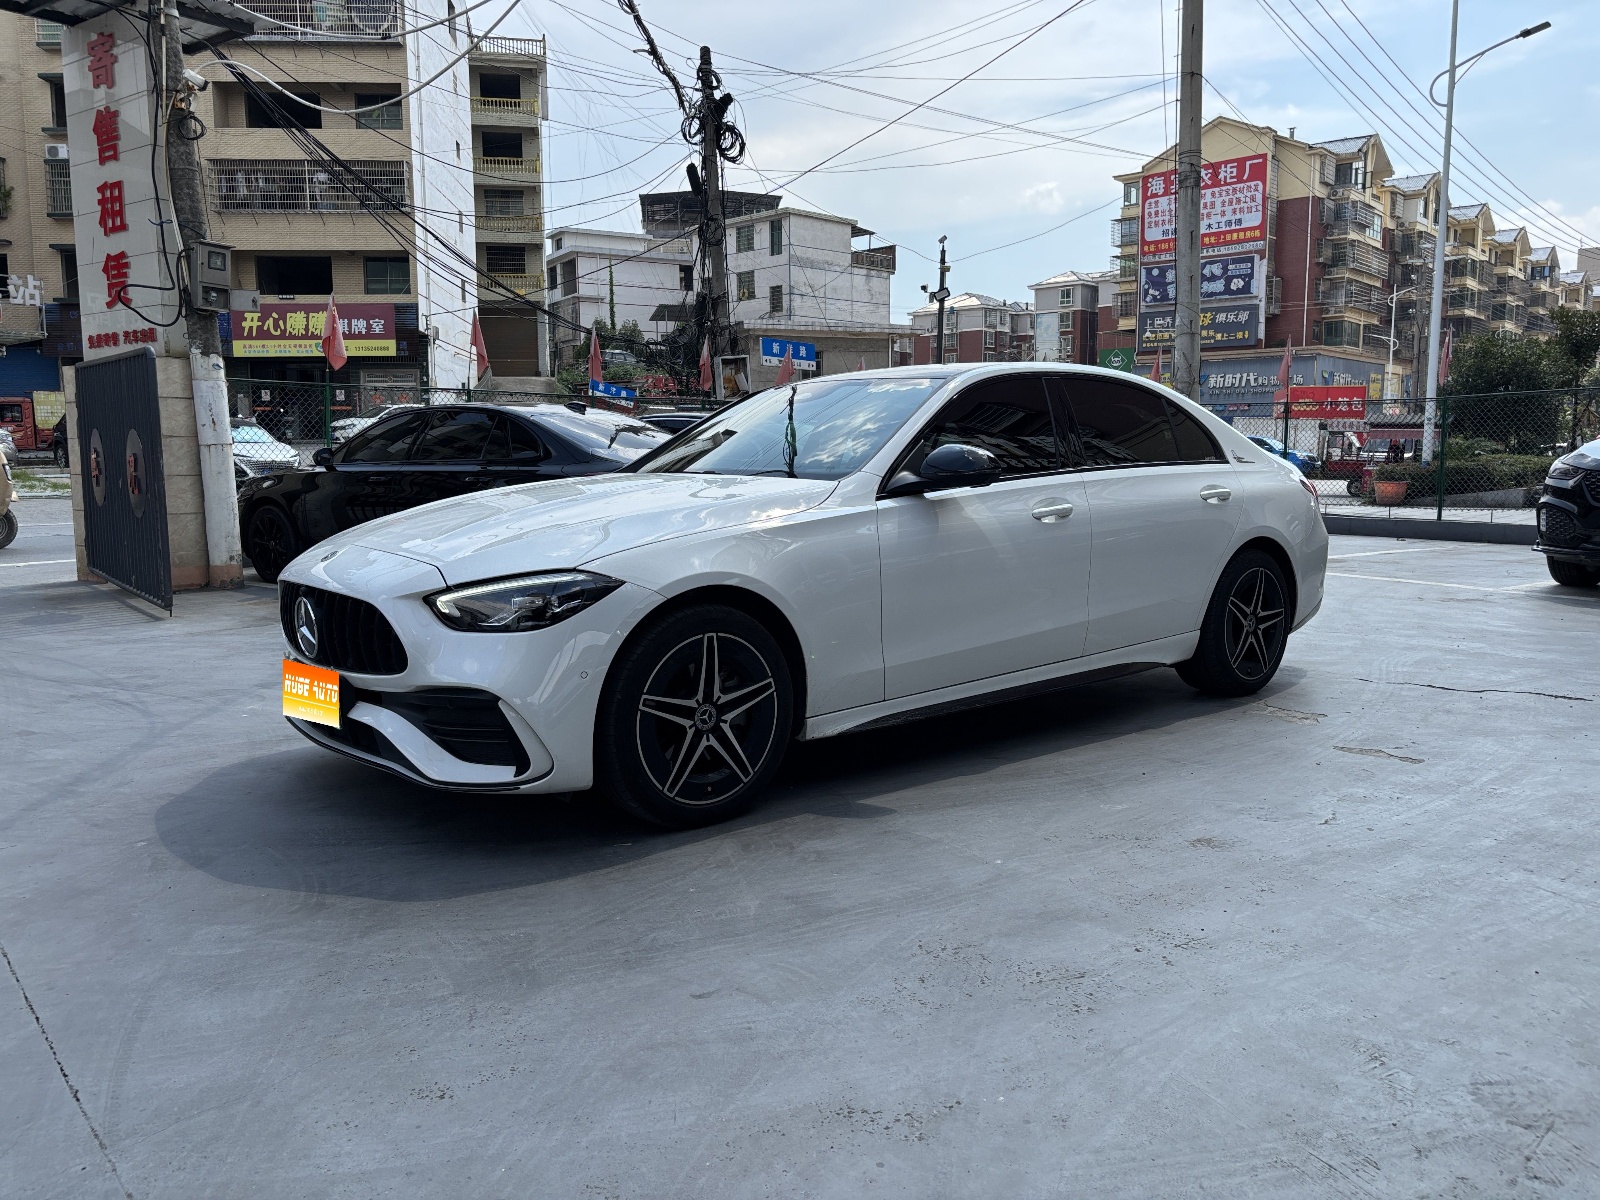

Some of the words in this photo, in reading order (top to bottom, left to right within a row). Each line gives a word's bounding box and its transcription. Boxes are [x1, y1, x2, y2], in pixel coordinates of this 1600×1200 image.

[87, 31, 133, 309] 寄售租赁
[7, 273, 42, 306] 站
